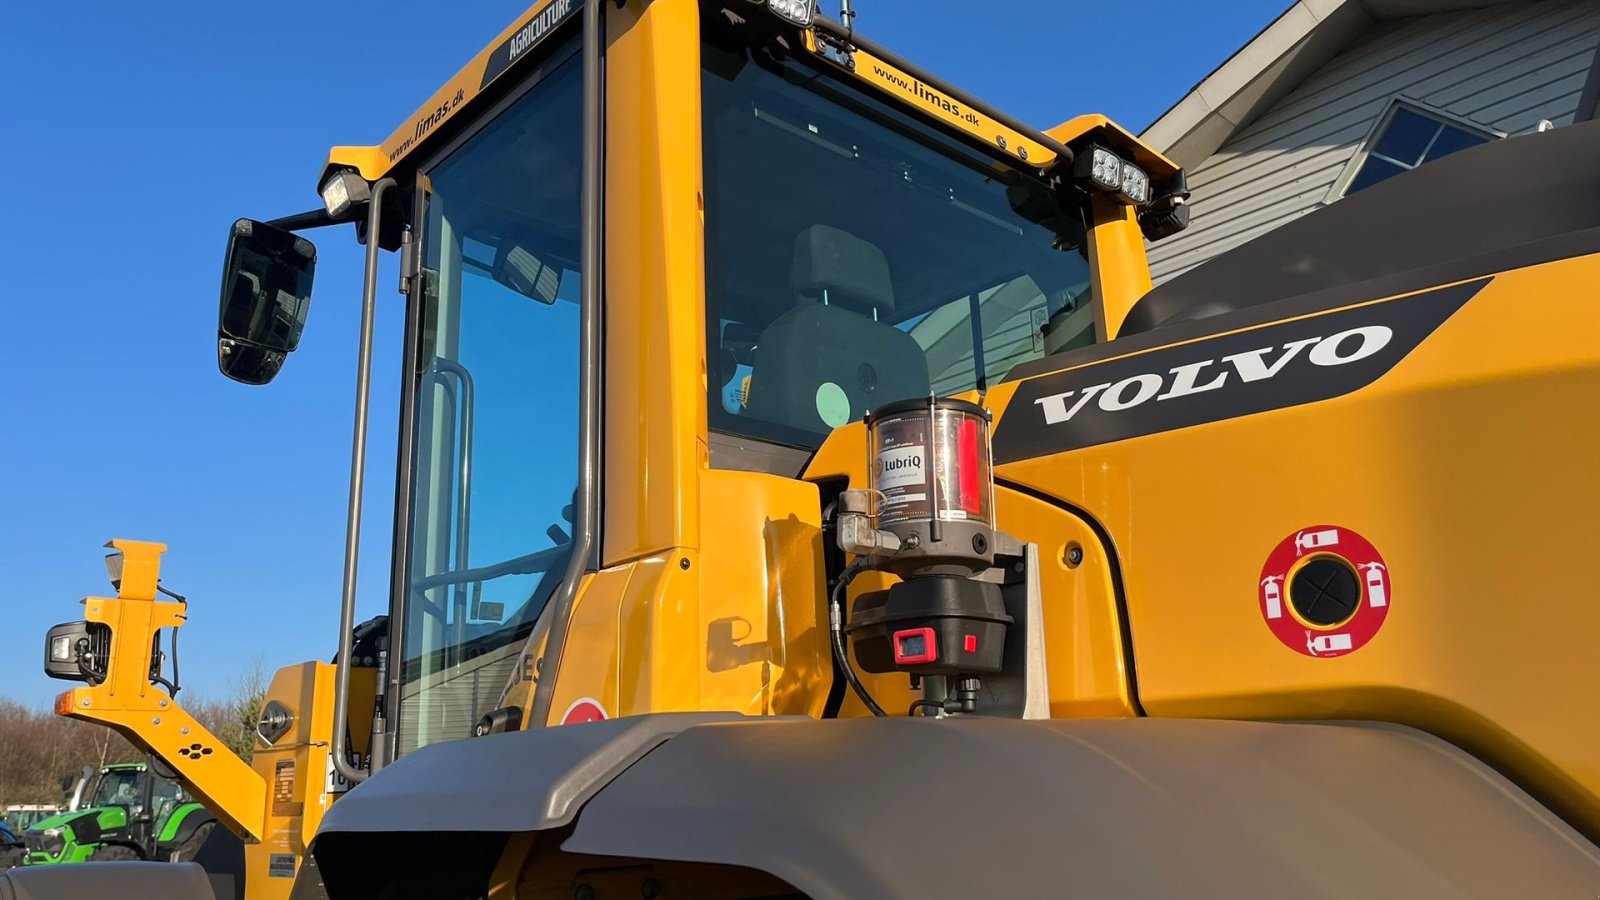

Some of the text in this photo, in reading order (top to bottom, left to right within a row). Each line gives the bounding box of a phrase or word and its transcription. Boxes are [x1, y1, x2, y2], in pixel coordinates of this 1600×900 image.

[509, 0, 571, 61] AGRICULTURE
[389, 88, 464, 163] www.limas.dk
[873, 65, 980, 127] www.limas.dk
[1034, 325, 1393, 425] VOLVO
[885, 456, 920, 471] LubriQ
